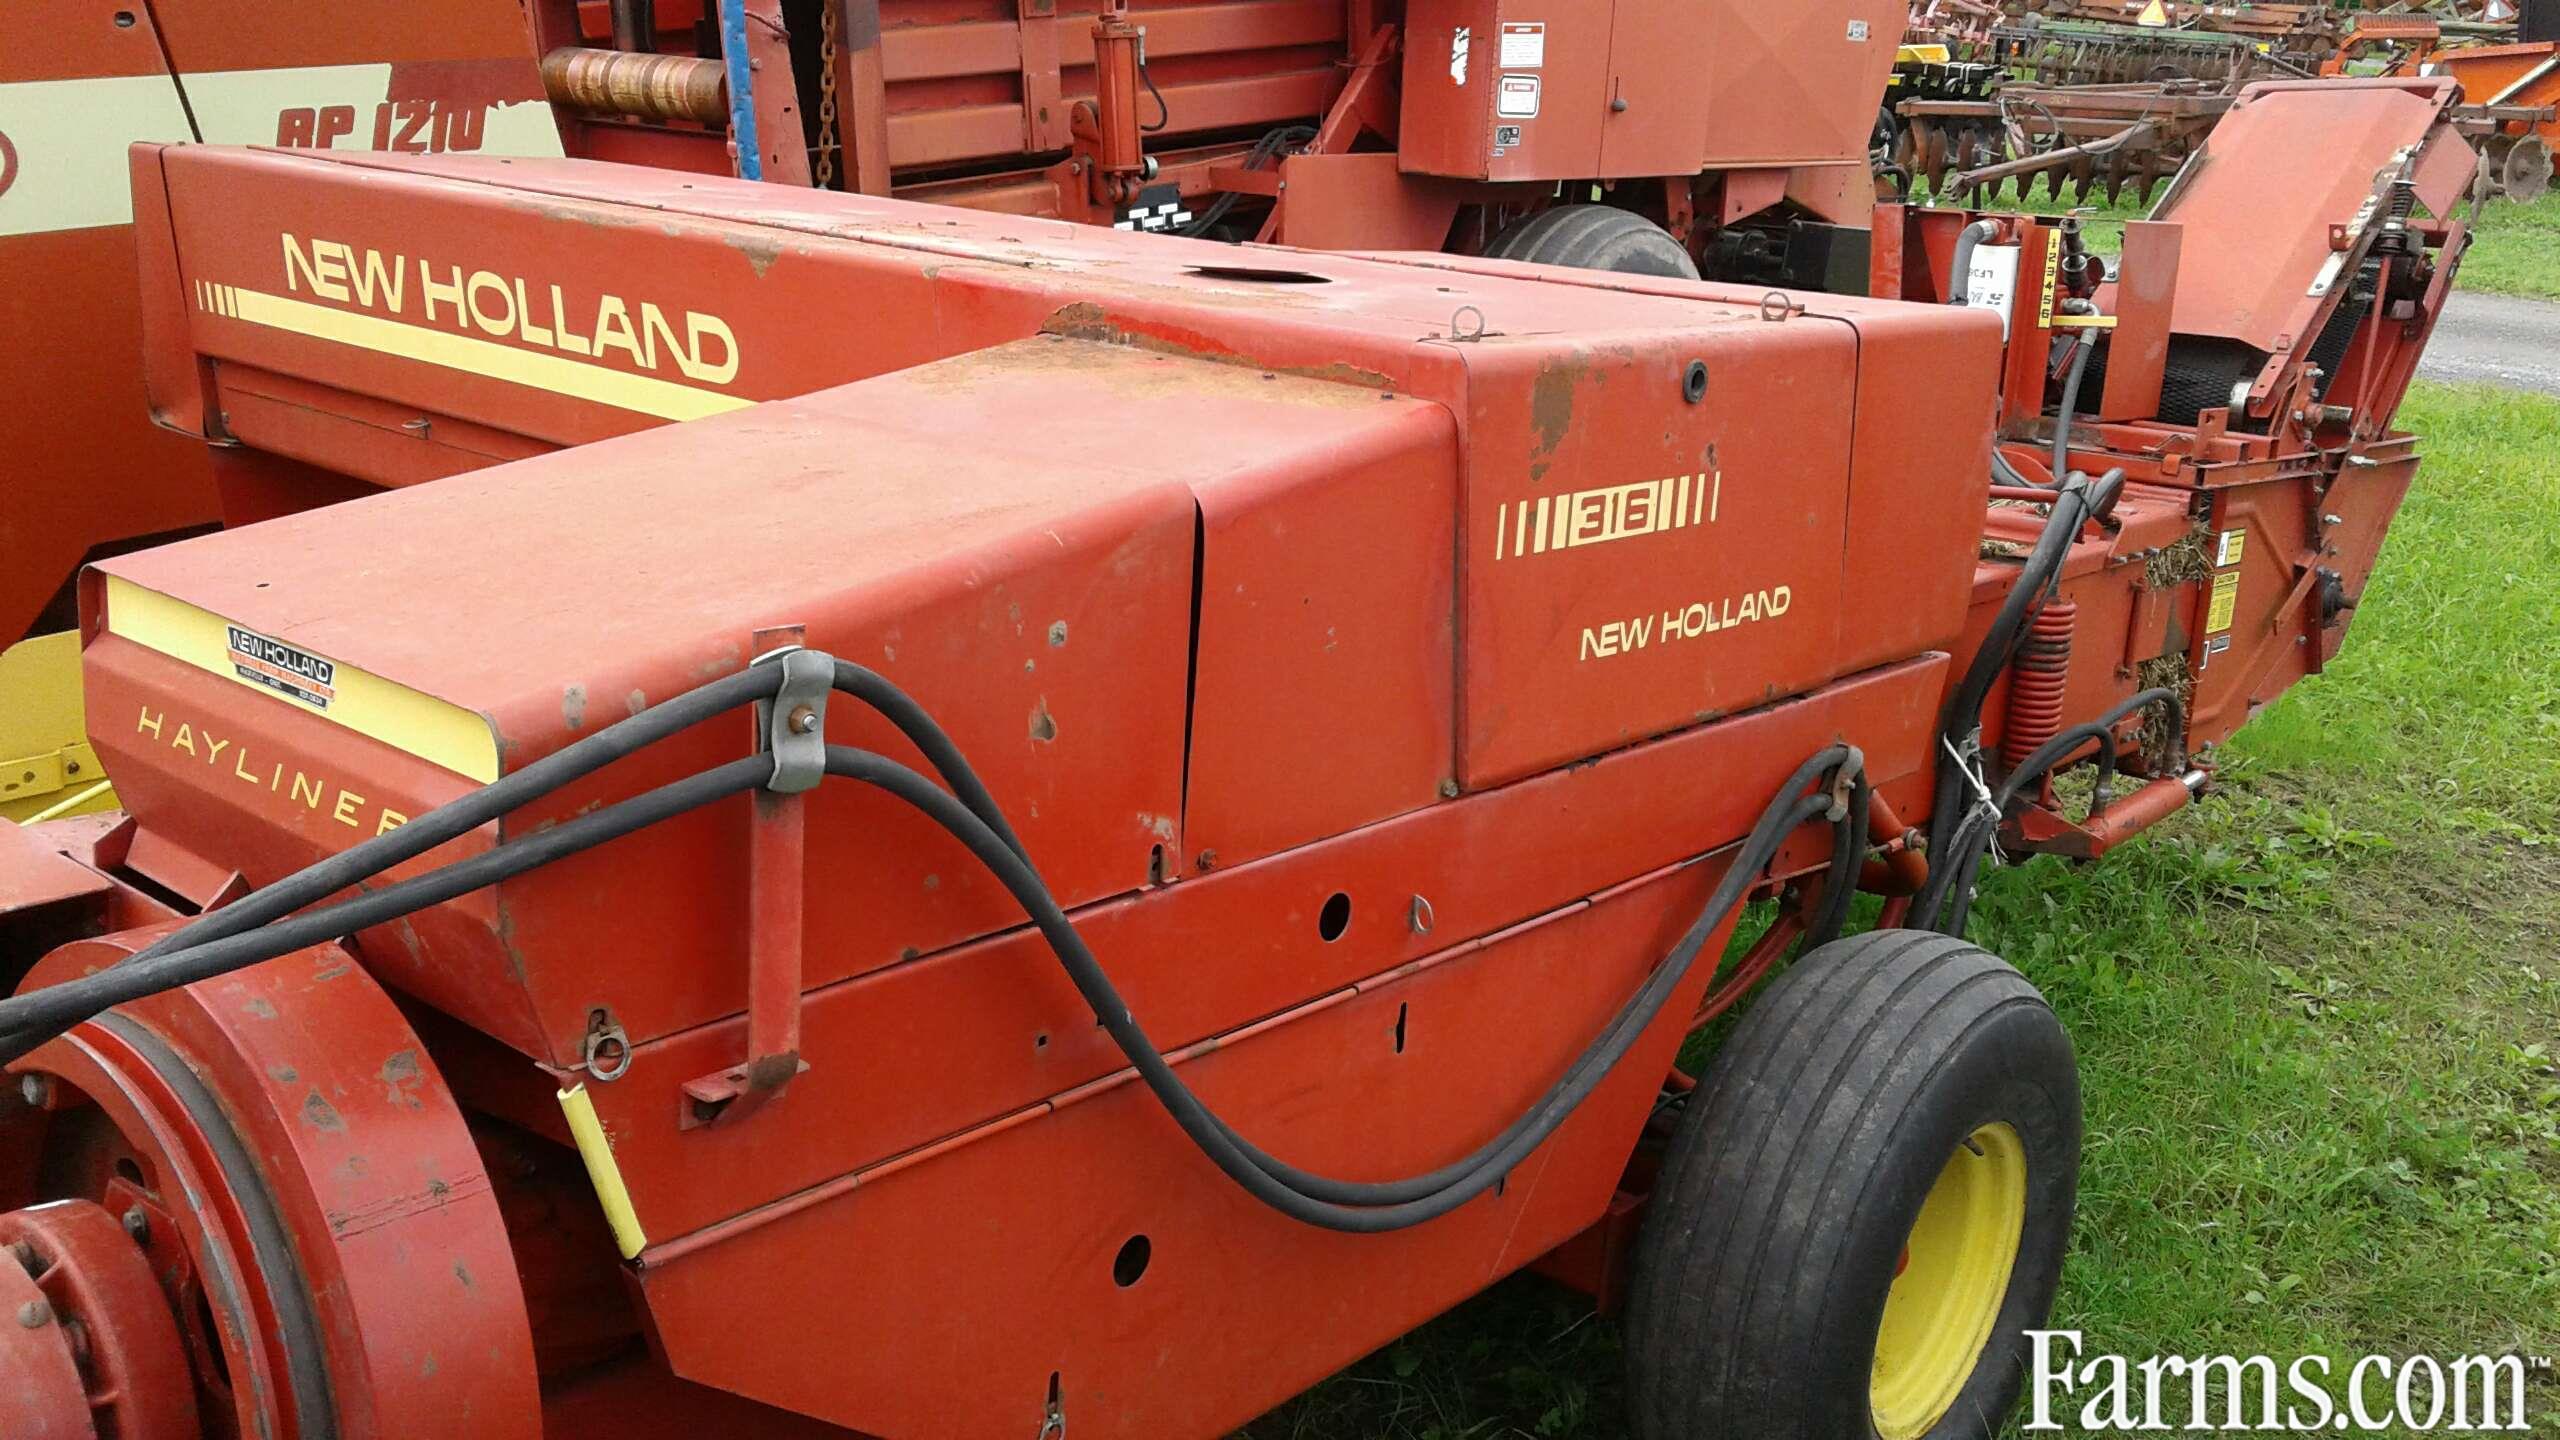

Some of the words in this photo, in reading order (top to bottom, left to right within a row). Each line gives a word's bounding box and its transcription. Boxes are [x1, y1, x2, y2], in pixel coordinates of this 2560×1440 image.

[282, 233, 405, 313] NEW
[420, 259, 740, 384] HOLLAND
[1574, 484, 1655, 543] 316
[233, 630, 262, 656] NEW
[265, 643, 329, 682] HOLLAND
[1580, 615, 1653, 661] NEW
[1661, 585, 1791, 643] HOLLAND
